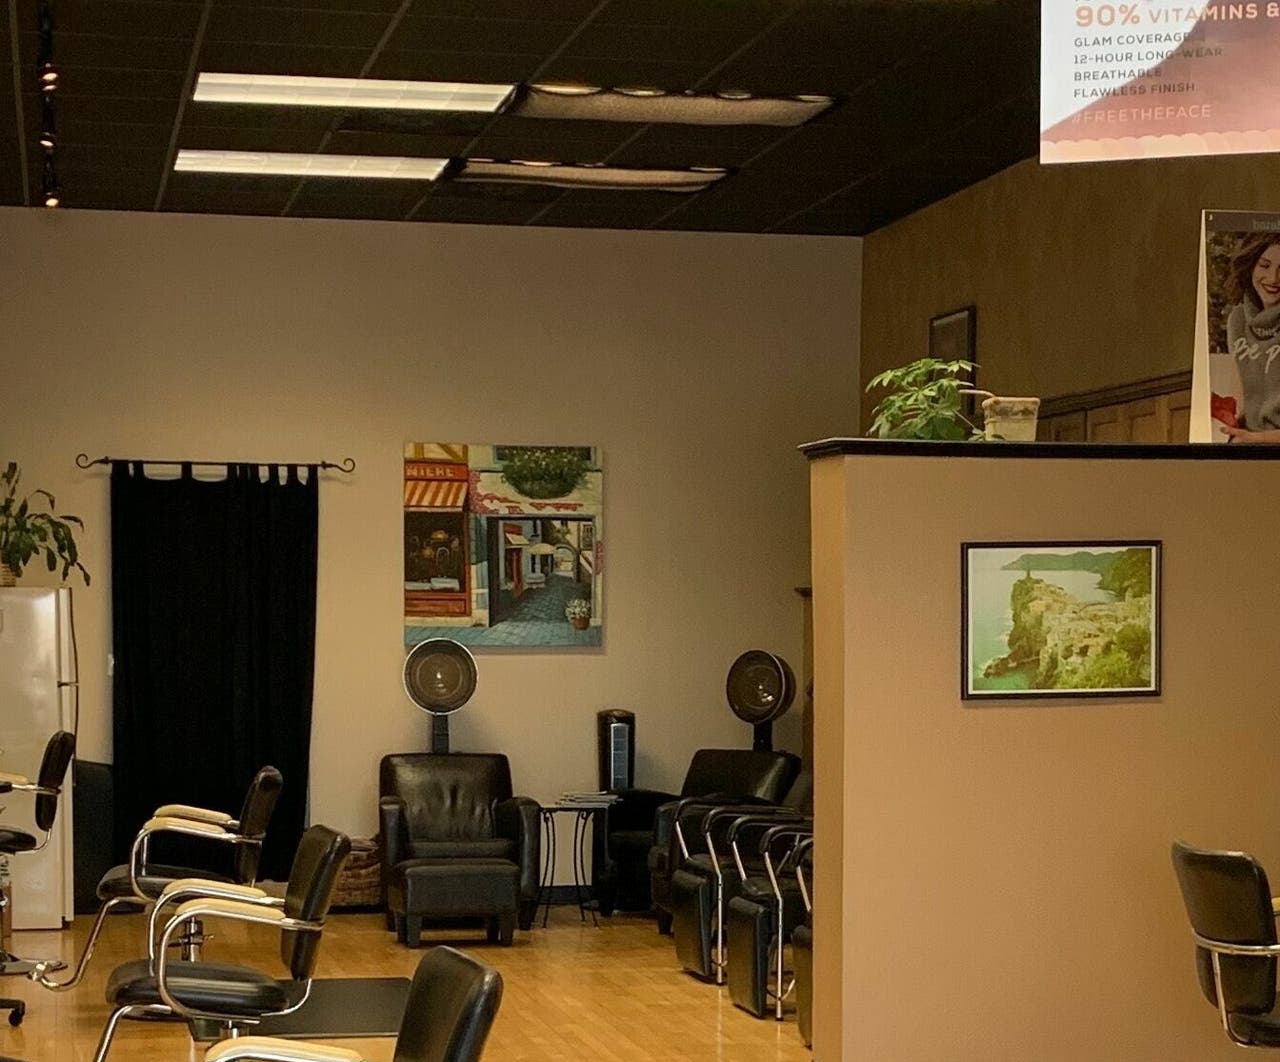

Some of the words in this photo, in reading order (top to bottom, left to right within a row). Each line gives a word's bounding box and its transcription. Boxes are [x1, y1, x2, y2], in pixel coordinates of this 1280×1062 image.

[1075, 3, 1141, 27] 90%
[1148, 3, 1258, 25] VITAMINS
[1266, 2, 1280, 18] &
[1073, 34, 1113, 47] GLAM
[1117, 31, 1190, 46] COVERAGE
[1073, 52, 1134, 65] 12-HOUR
[1136, 47, 1223, 61] LONG-WEAR
[1073, 67, 1162, 82] BREATHABLE
[1073, 84, 1147, 99] FLAWLESS
[1150, 82, 1196, 95] FINISH
[1071, 104, 1212, 124] #FREETHEFACE
